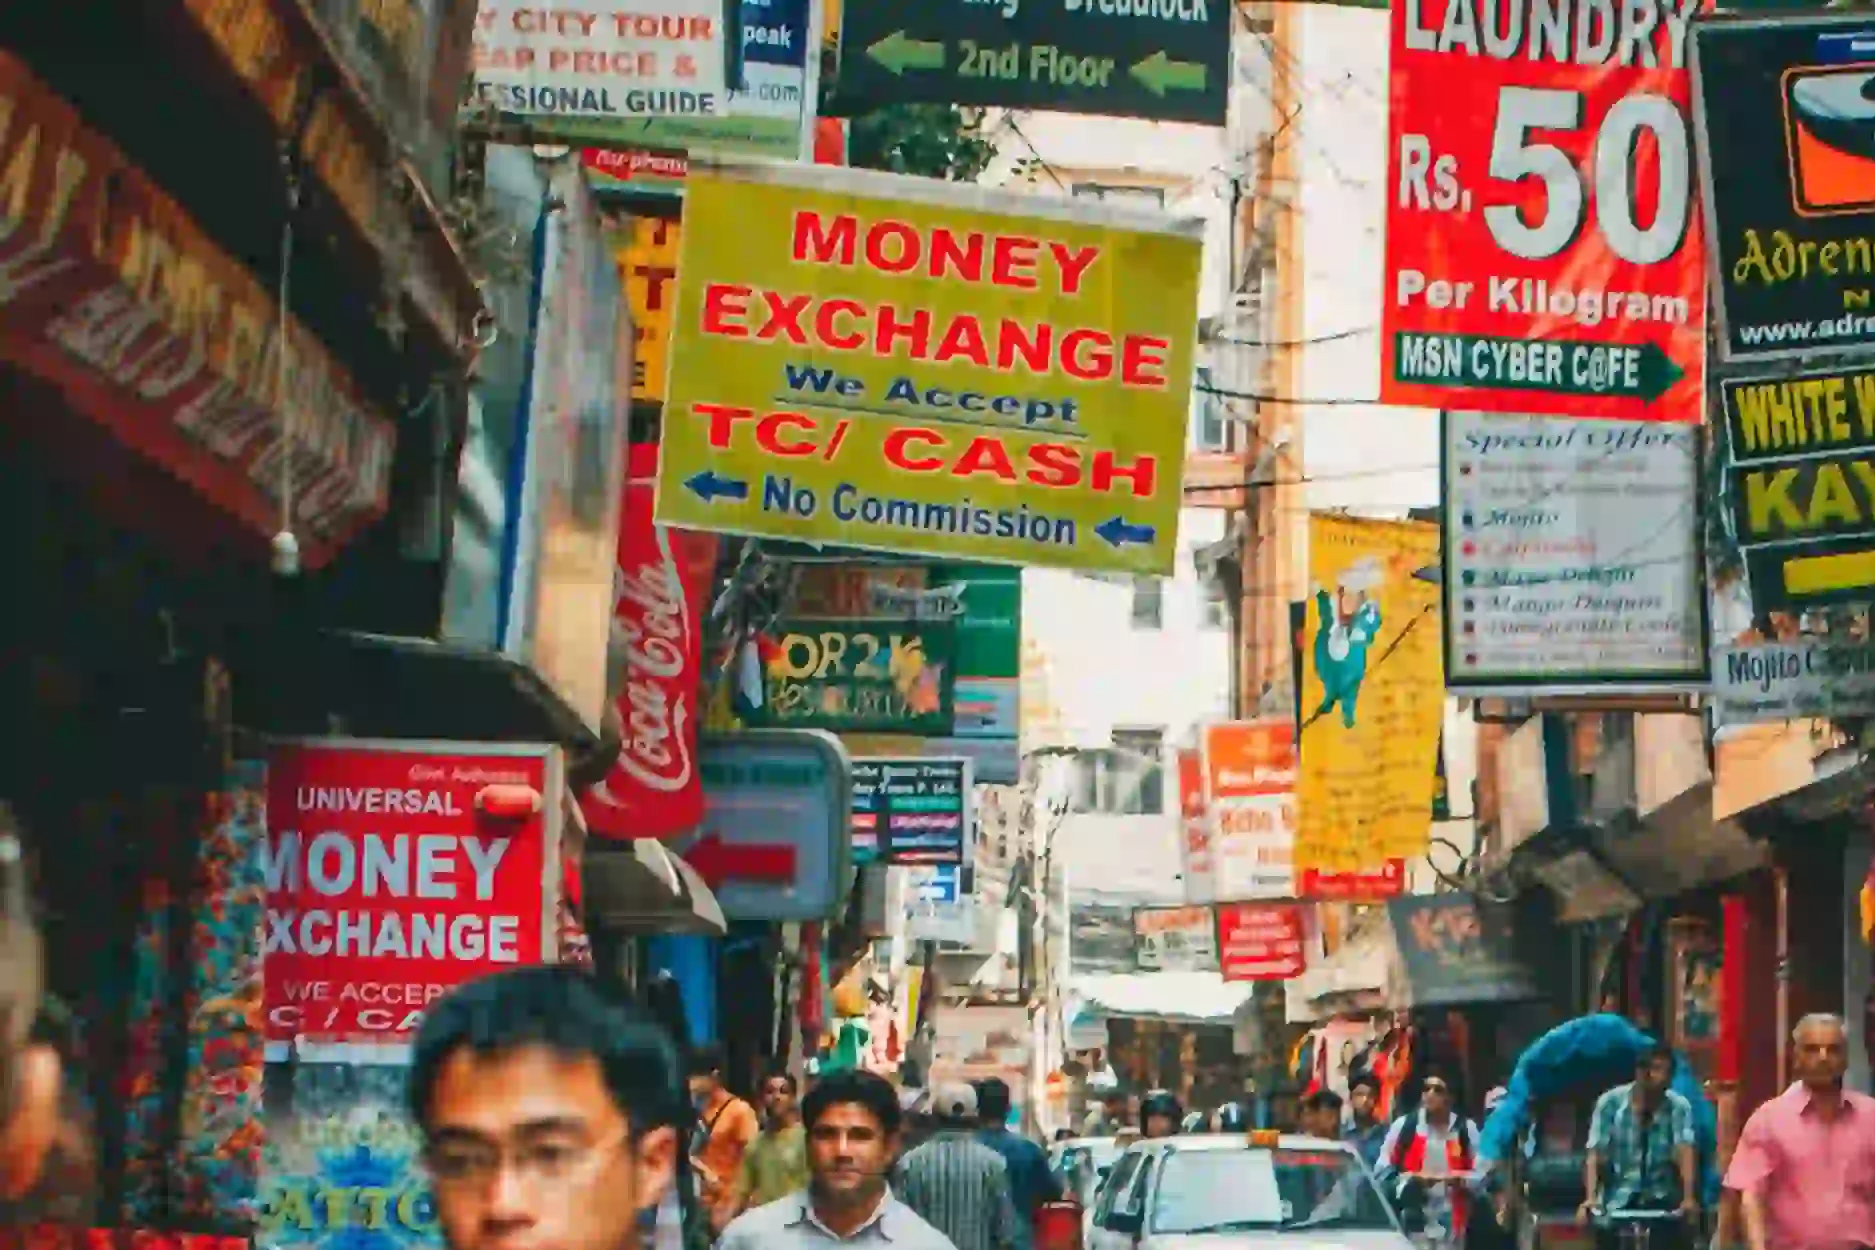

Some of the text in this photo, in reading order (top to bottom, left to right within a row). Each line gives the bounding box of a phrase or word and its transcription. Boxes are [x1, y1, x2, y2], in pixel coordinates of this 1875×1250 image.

[512, 7, 598, 37] CITY
[612, 11, 715, 41] TOUR
[1405, 0, 1692, 69] LAUNDRY
[550, 50, 659, 78] PRICE
[957, 39, 1115, 88] 2nd Floor
[476, 82, 716, 114] ESSIONAL GUIDE
[1399, 84, 1690, 265] Rs. 50
[792, 210, 1101, 296] MONEY
[1396, 268, 1689, 326] Per Kilogram
[700, 283, 1173, 389] EXCHANGE
[1400, 334, 1643, 392] MSN CYBER C@FE
[784, 363, 1080, 426] We Accept
[1735, 378, 1850, 452] WHITE
[691, 403, 1158, 498] TC/ CASH
[761, 474, 1077, 547] No Commission
[296, 786, 464, 817] UNIVERSAL
[262, 829, 512, 901] MONEY
[264, 907, 520, 963] XCHANGE
[282, 980, 455, 1006] WE ACCEP
[356, 1008, 424, 1032] CA
